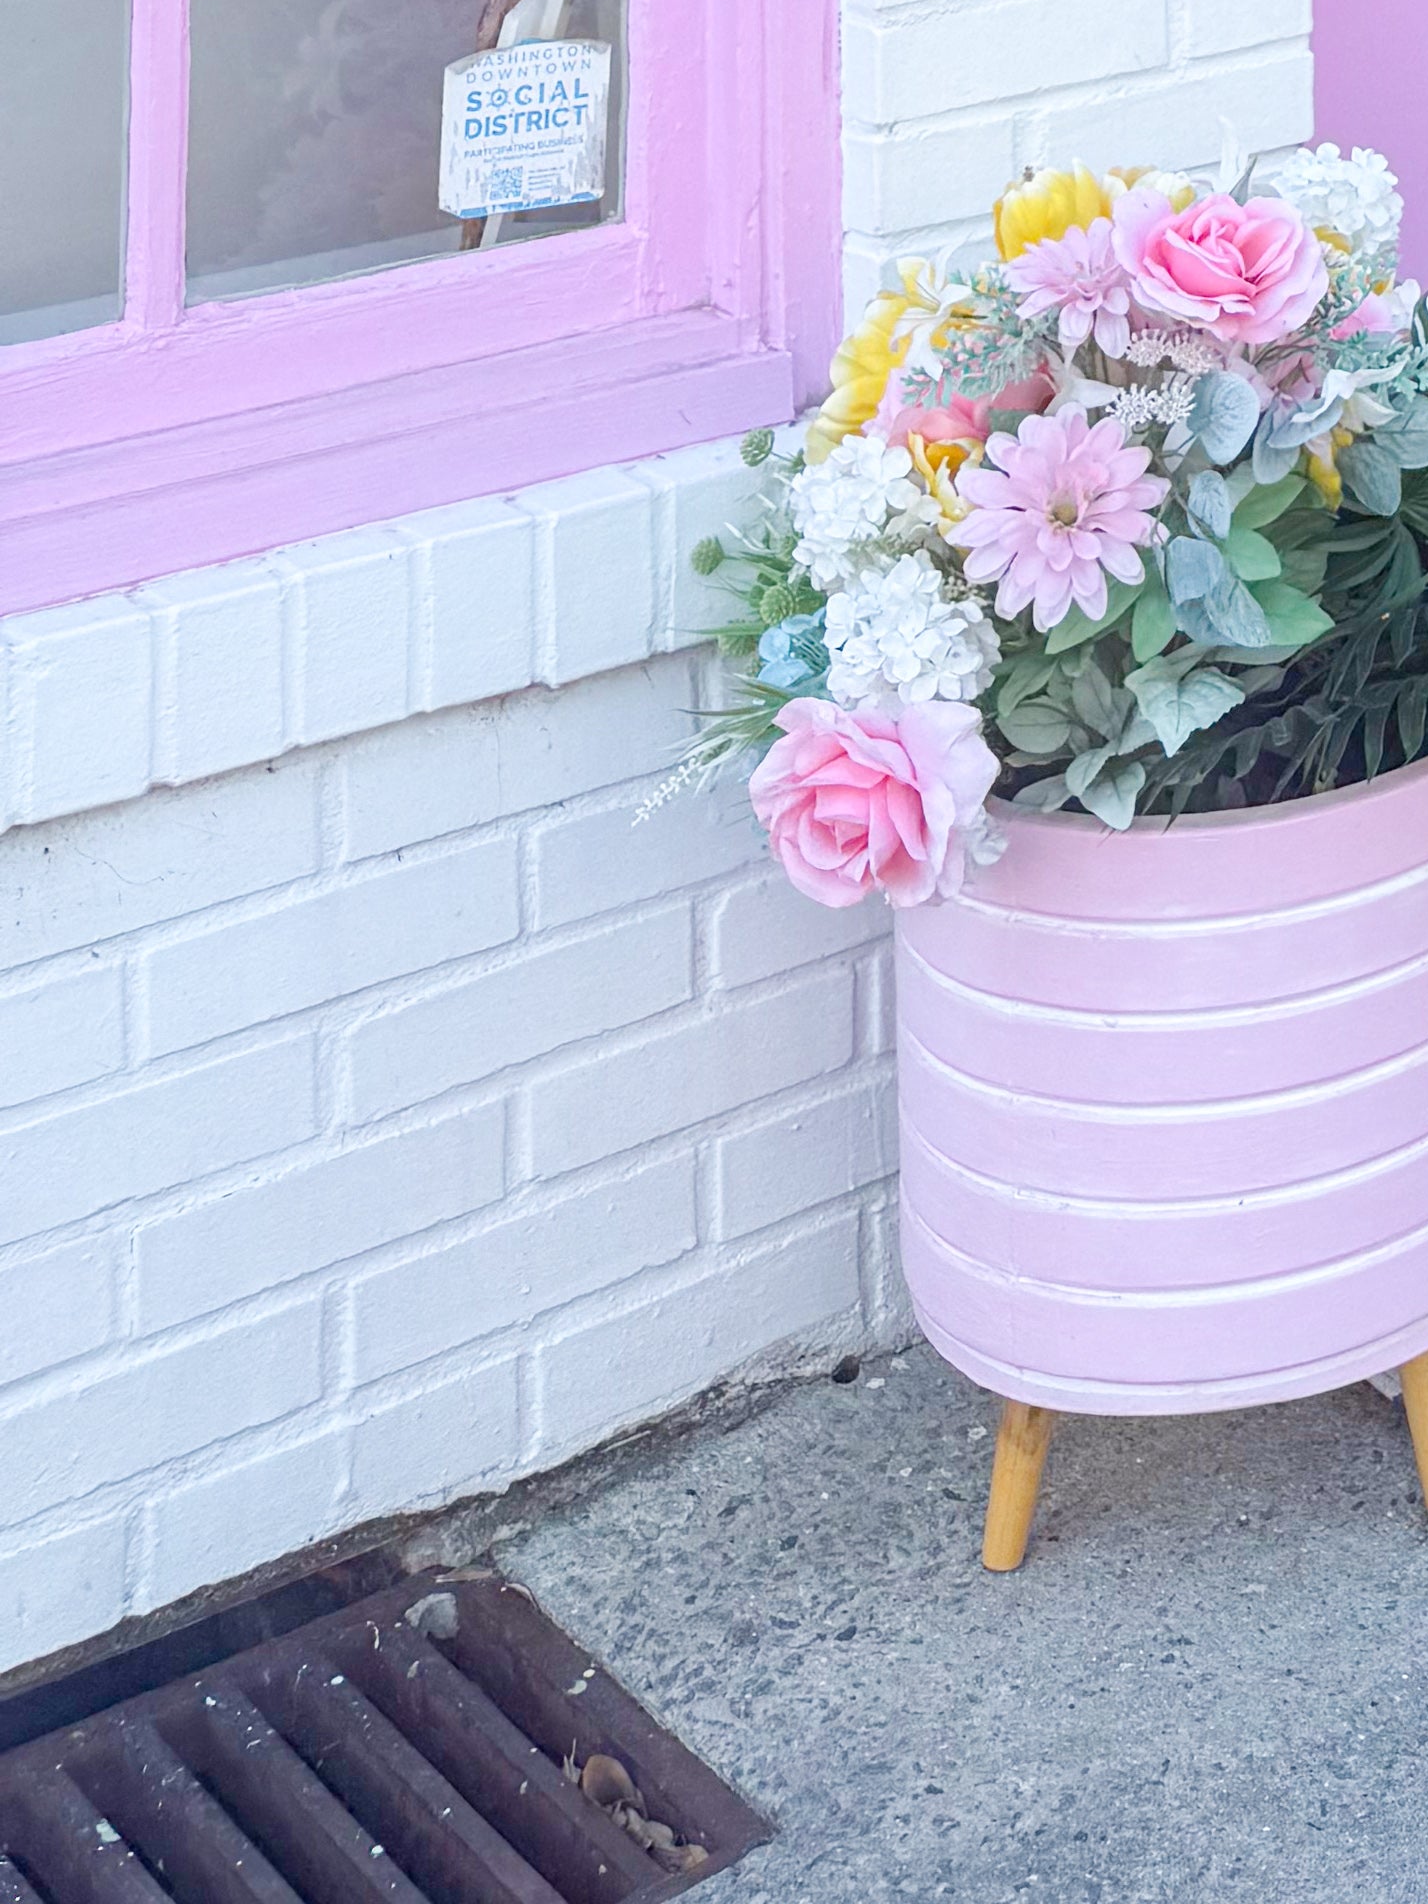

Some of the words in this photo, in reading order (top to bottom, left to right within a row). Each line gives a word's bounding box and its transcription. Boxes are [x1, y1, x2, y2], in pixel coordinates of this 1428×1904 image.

[466, 59, 591, 84] DOWNTOWN
[466, 78, 589, 112] SOCIAL
[464, 105, 588, 139] DISTRICT
